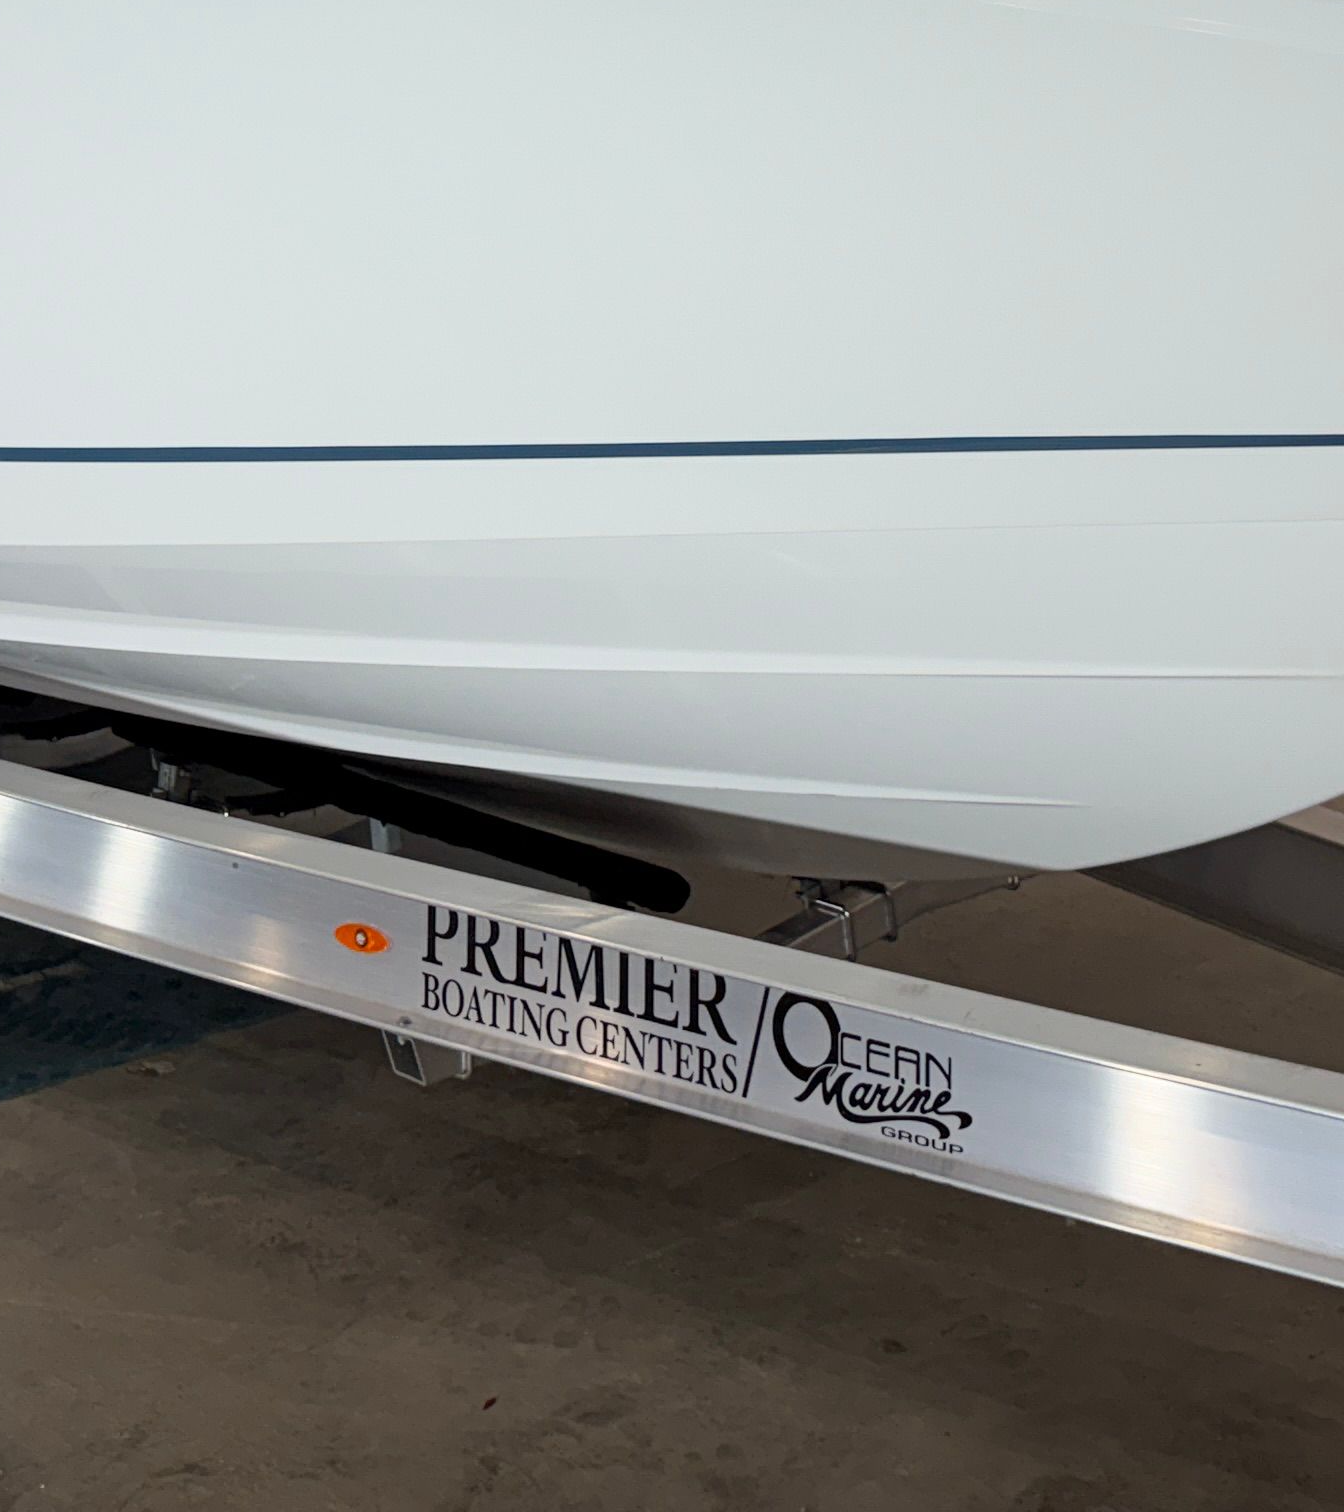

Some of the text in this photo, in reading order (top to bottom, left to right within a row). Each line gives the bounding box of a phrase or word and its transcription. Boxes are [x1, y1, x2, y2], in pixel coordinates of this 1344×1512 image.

[422, 904, 738, 1046] PREMIER
[422, 971, 738, 1094] BOATING CENTERS
[772, 991, 952, 1090] OCEAN
[794, 1063, 973, 1140] Marine
[880, 1125, 964, 1155] GROUP
